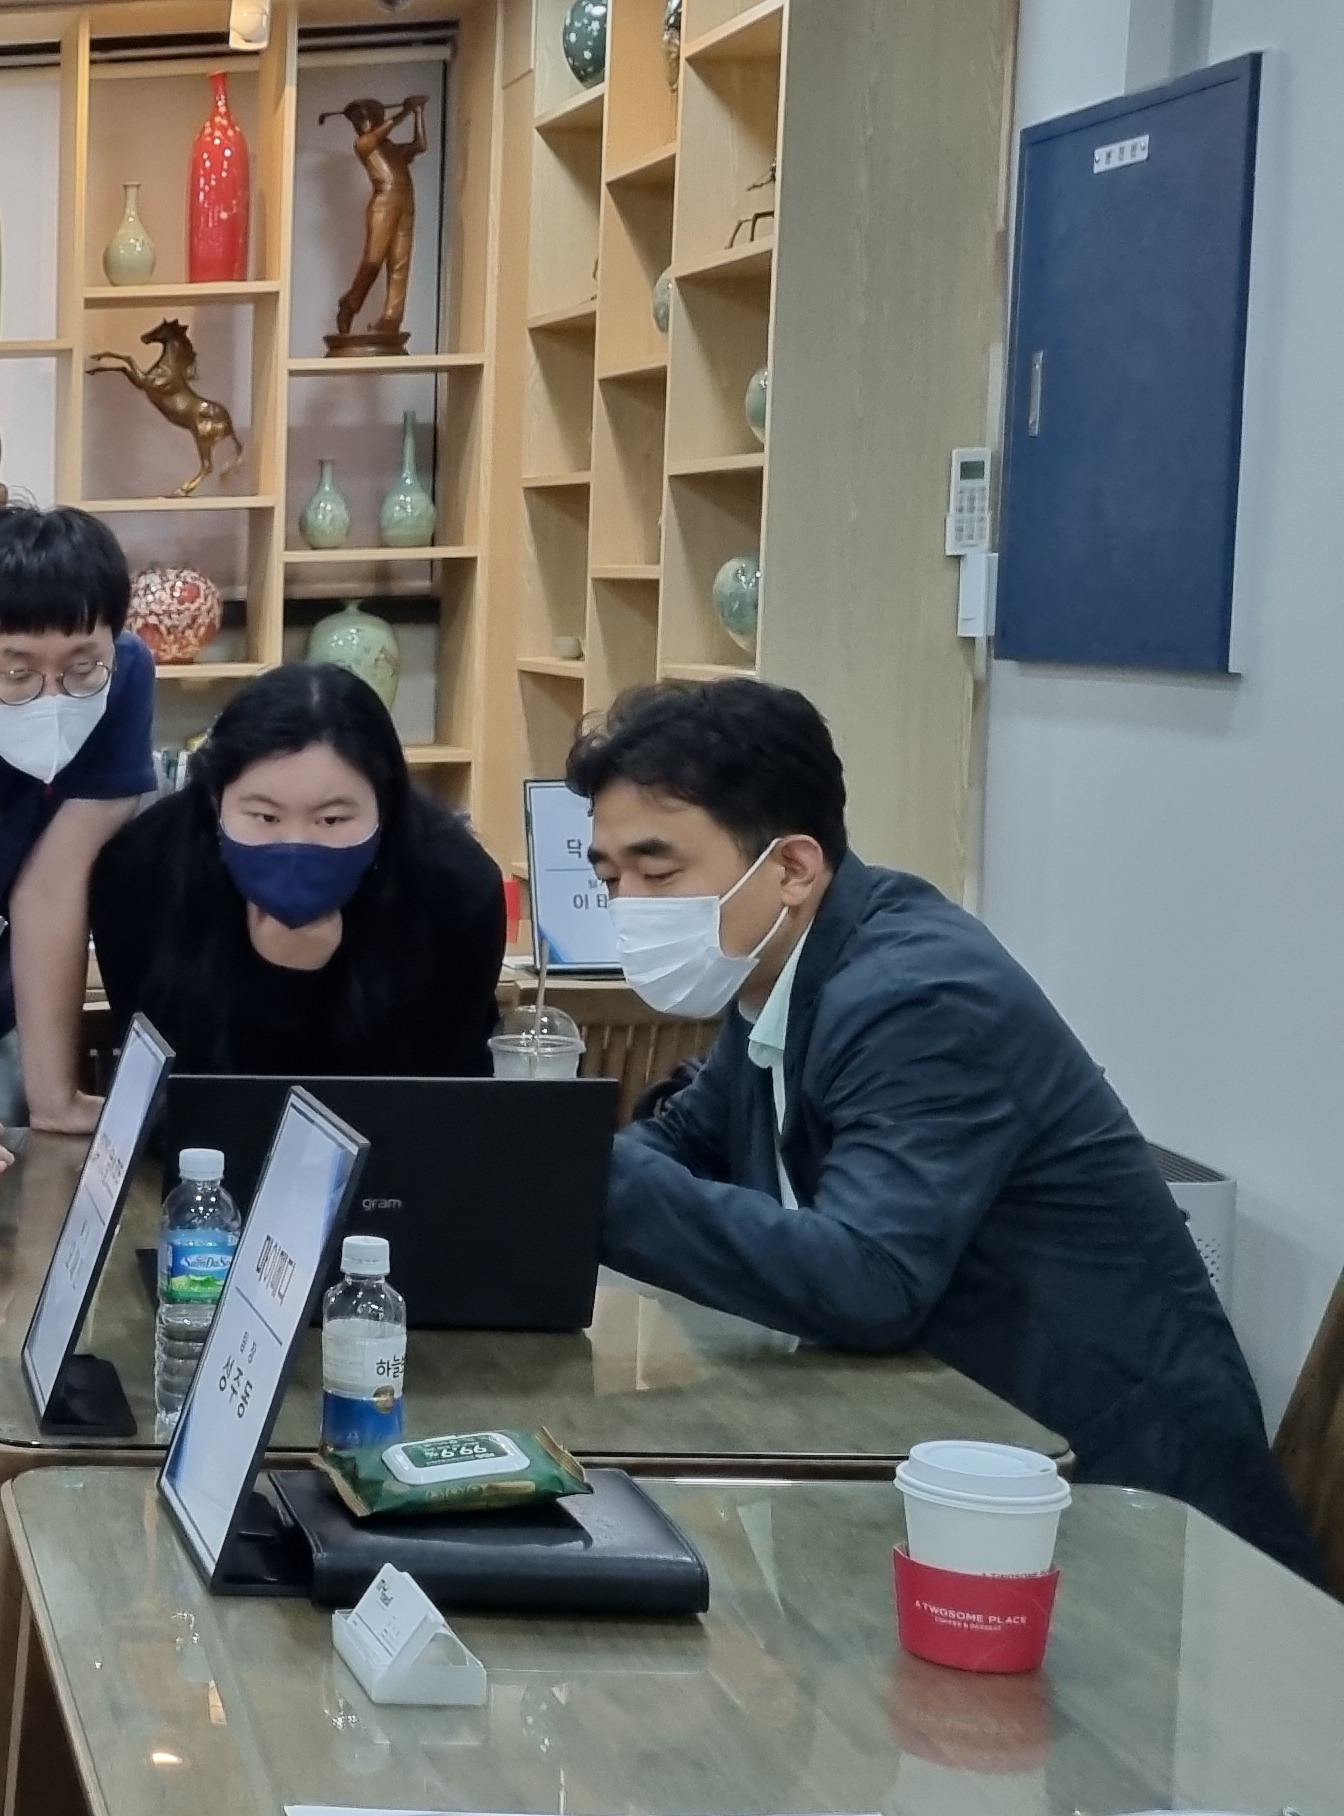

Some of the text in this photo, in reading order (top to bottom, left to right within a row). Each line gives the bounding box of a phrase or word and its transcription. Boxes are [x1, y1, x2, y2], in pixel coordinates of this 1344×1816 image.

[362, 1198, 403, 1212] gram
[921, 1602, 984, 1624] TWOSOME
[988, 1615, 1027, 1625] PLACE
